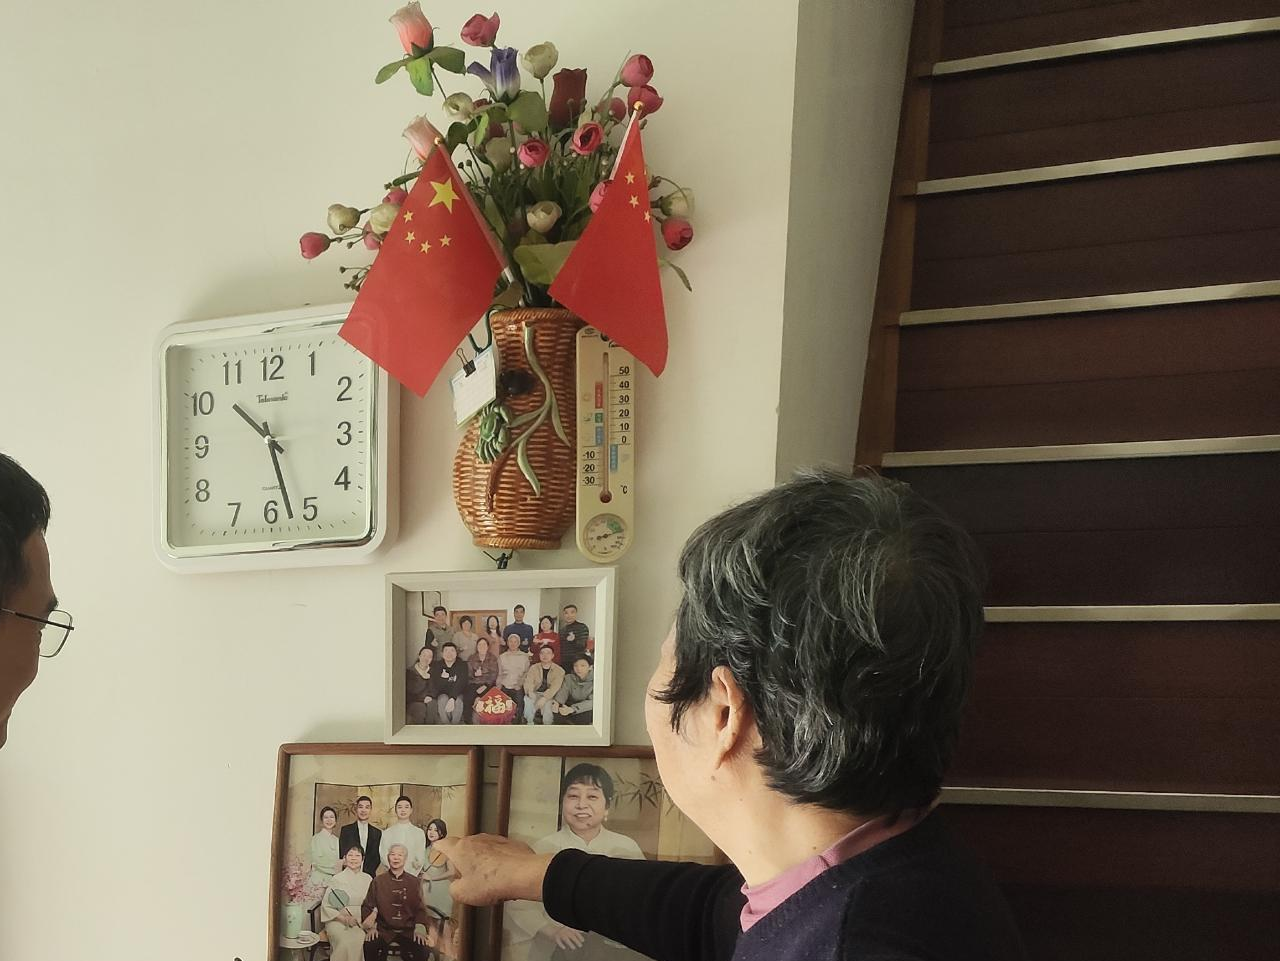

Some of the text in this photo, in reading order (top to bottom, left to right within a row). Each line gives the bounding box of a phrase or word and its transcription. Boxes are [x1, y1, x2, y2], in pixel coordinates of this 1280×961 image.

[223, 359, 242, 385] 11
[260, 355, 285, 382] 12
[308, 351, 315, 376] 1
[619, 366, 630, 375] 50
[336, 376, 353, 402] 2
[619, 395, 630, 403] 30
[191, 391, 215, 417] 10
[619, 409, 630, 417] 20
[336, 421, 352, 446] 3
[194, 435, 209, 459] 9
[583, 451, 595, 459] -10
[334, 466, 351, 491] 4
[583, 464, 595, 472] -20
[195, 479, 210, 502] 8
[227, 502, 242, 527] 7
[263, 500, 278, 524] 6
[302, 496, 318, 522] 5
[484, 695, 506, 714] 福
